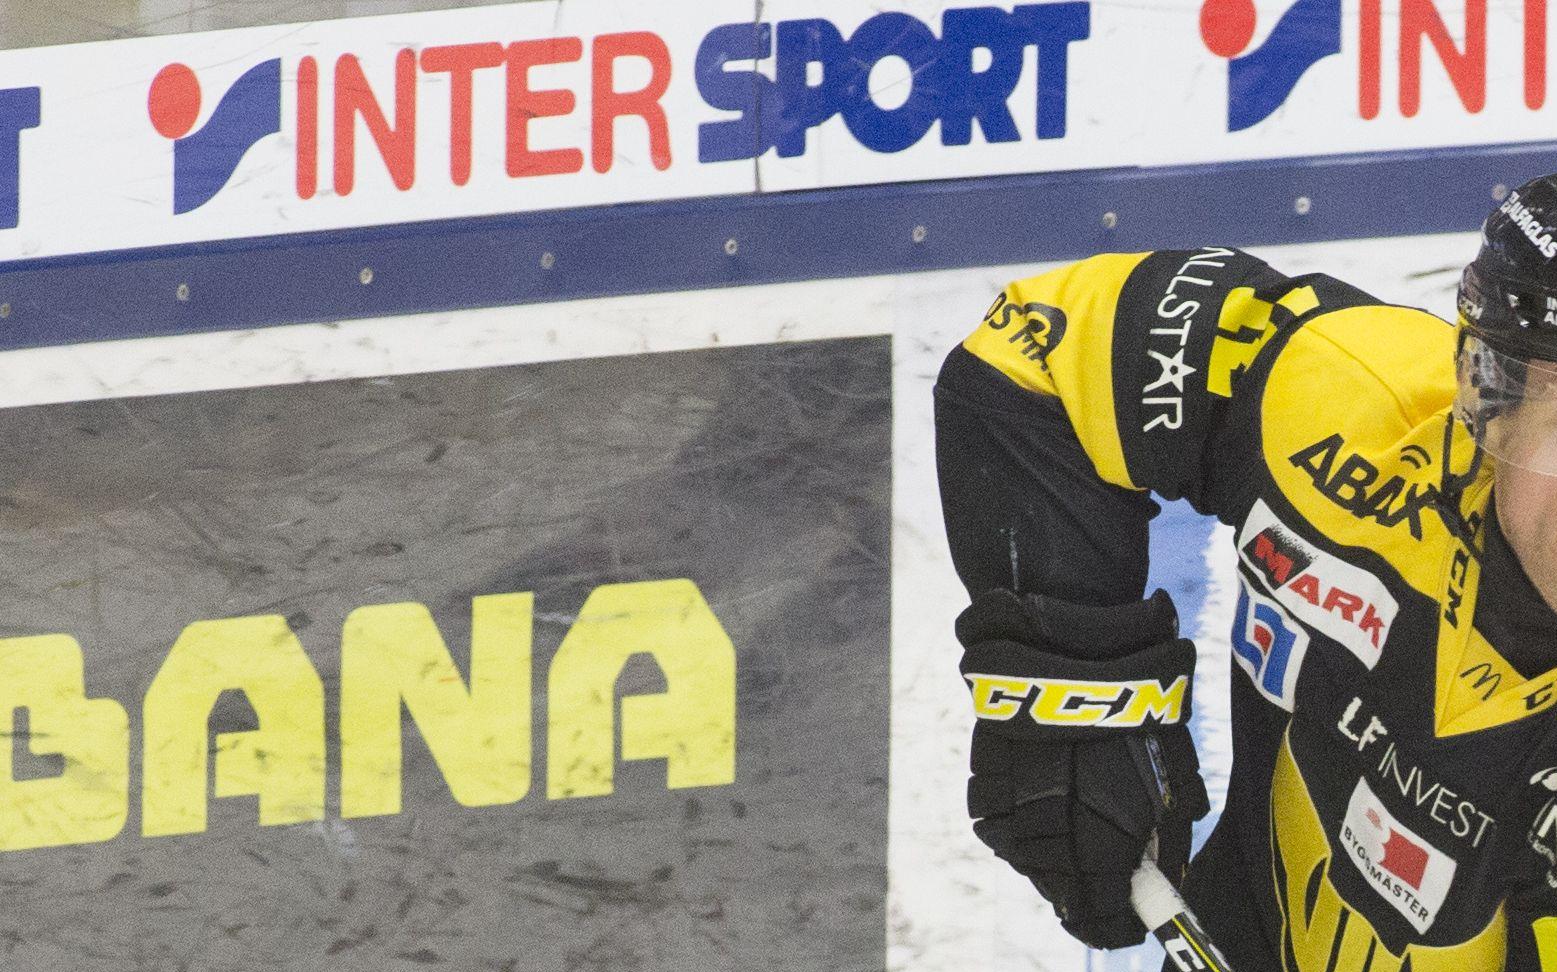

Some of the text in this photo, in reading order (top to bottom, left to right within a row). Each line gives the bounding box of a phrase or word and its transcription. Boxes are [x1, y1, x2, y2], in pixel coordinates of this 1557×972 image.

[296, 2, 1091, 200] INTERSPORT
[1288, 433, 1441, 541] ABAX
[1254, 532, 1386, 650] MARK
[964, 673, 1188, 728] CCM
[1338, 697, 1495, 848] LF INVEST
